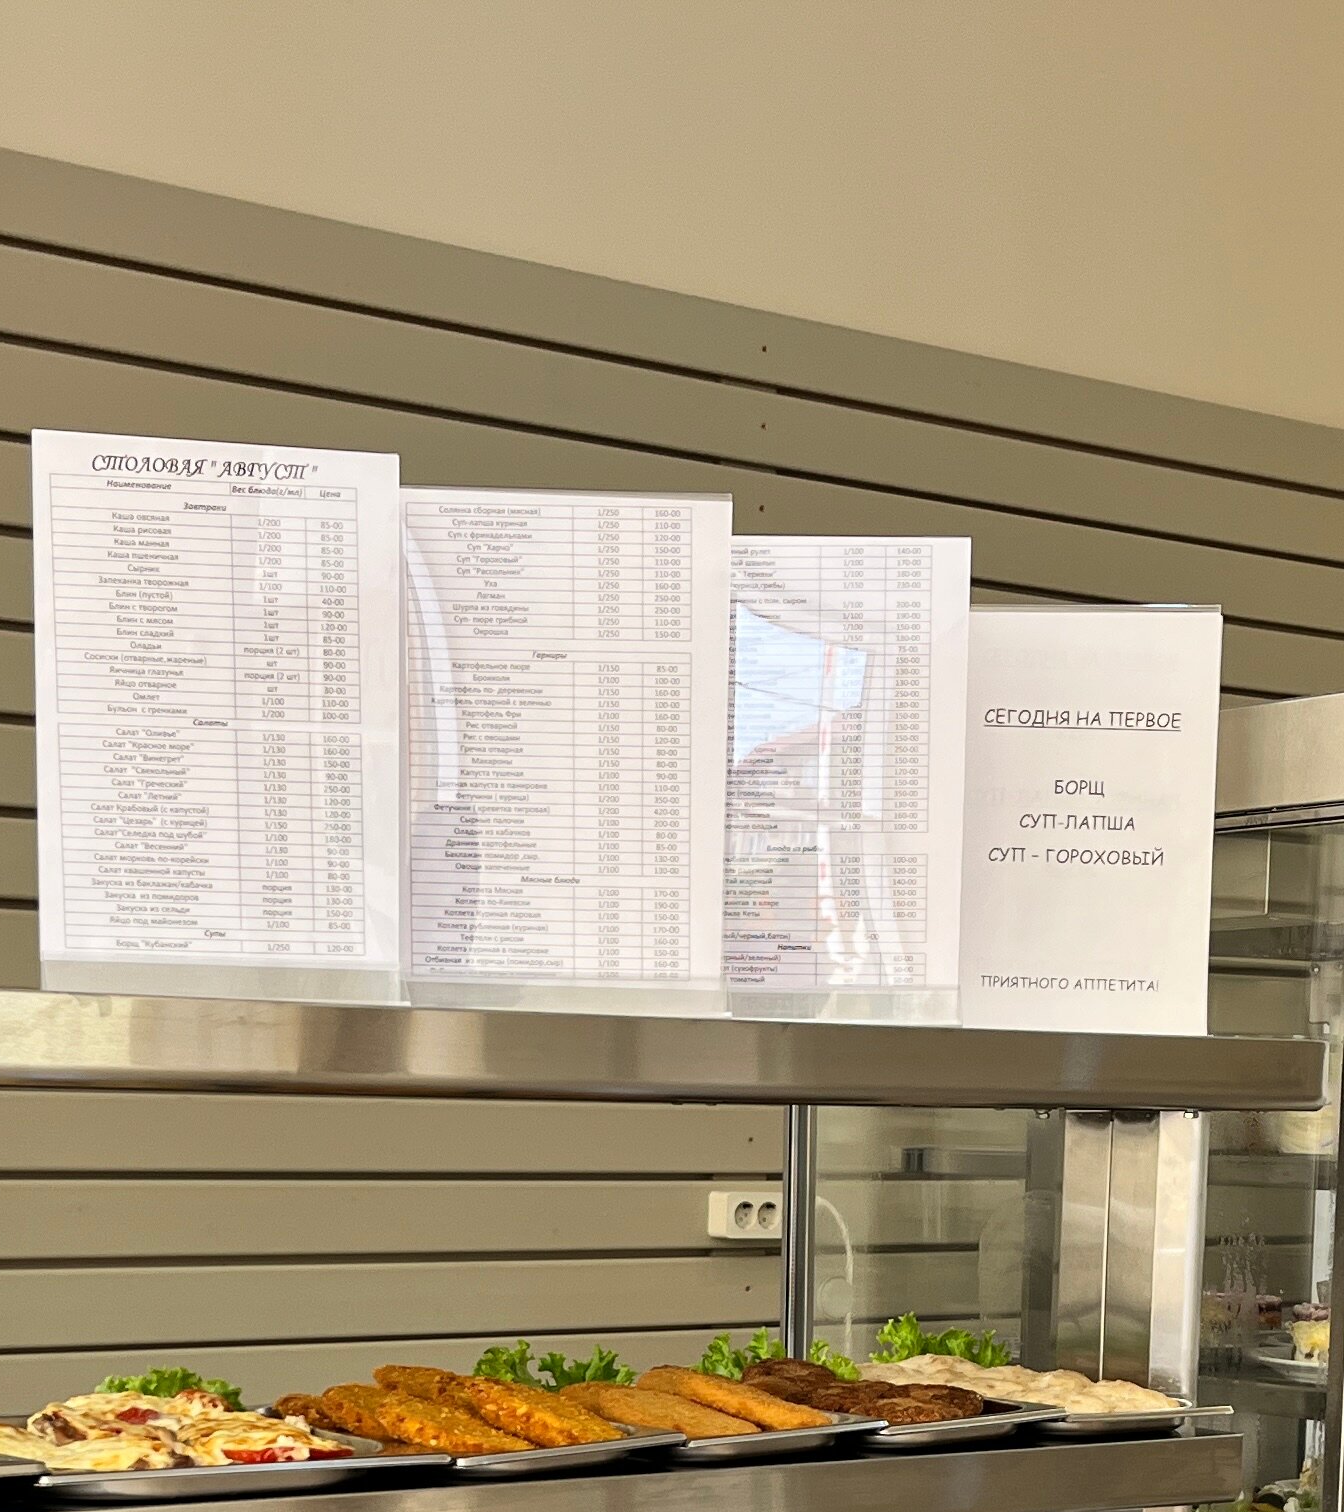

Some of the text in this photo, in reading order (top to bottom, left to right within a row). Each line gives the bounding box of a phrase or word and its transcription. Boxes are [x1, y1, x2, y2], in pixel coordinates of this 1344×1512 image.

[91, 454, 208, 477] СТОЛОВАЯ
[257, 517, 281, 528] 1/200
[257, 530, 281, 540] 1/200
[597, 532, 620, 542] 1/250
[258, 542, 282, 553] 1/200
[597, 544, 620, 554] 1/250
[844, 547, 864, 555] 1/100
[258, 555, 282, 566] 1/200
[261, 569, 278, 578] 1шт
[258, 581, 282, 592] 1/100
[597, 580, 619, 590] 1/250
[262, 595, 279, 604] 1шт
[262, 607, 279, 617] 1шт
[263, 620, 279, 630] 1шт
[263, 633, 280, 642] 1шт
[597, 628, 619, 638] 1/250
[261, 696, 285, 707] 1/100
[261, 708, 285, 719] 1/200
[598, 711, 619, 720] 1/100
[983, 708, 1181, 729] СЕГОДНЯ НА ПЕРВОЕ
[262, 732, 285, 742] 1/130
[262, 744, 286, 755] 1/130
[598, 758, 620, 768] 1/150
[598, 770, 619, 780] 1/100
[263, 782, 287, 793] 1/130
[1053, 779, 1105, 797] БОРЩ
[263, 795, 287, 805] 1/130
[1018, 813, 1136, 831] СУП-ЛАПША
[264, 845, 288, 855] 1/130
[987, 847, 1027, 863] СУП
[1046, 847, 1165, 867] ГОРОХОВЫЙ
[980, 974, 1160, 992] ПРИЯТНОГО АППЕТИТА!
